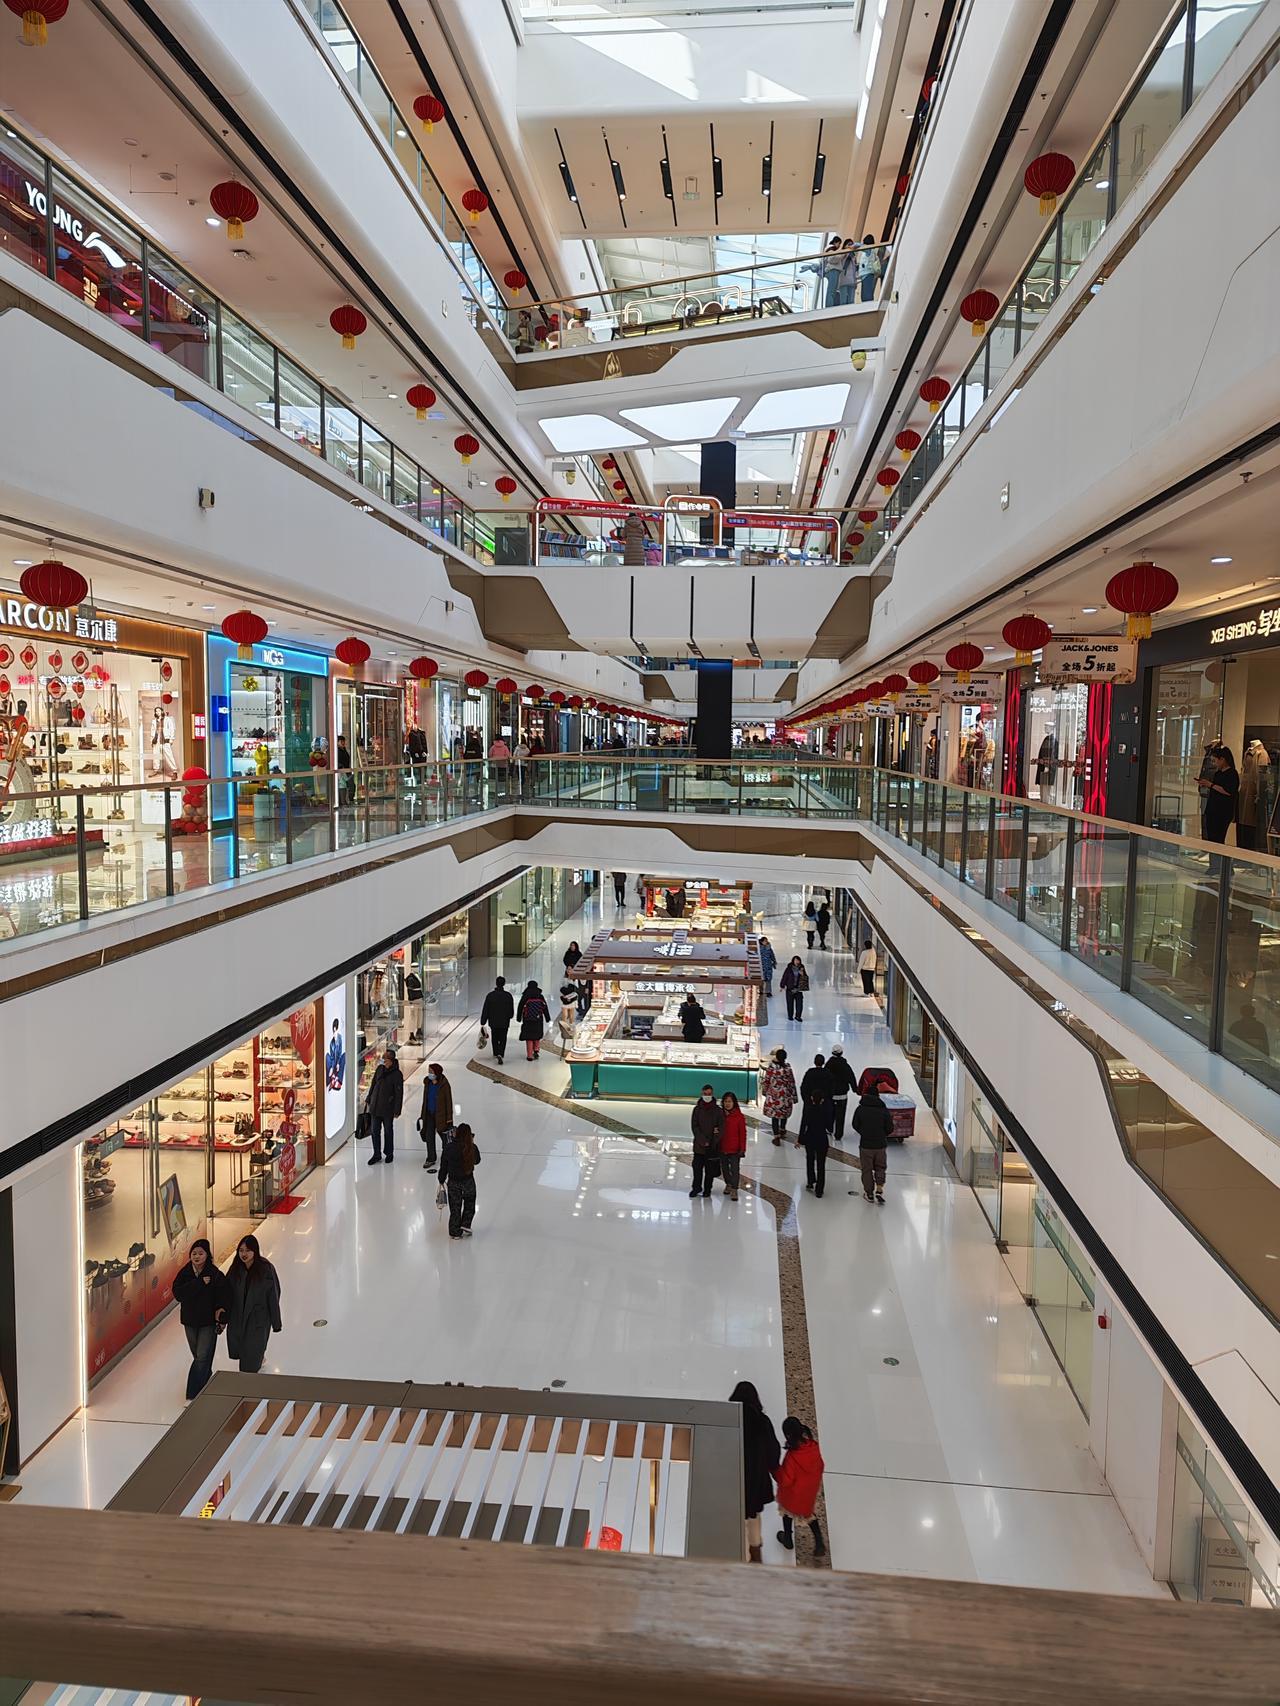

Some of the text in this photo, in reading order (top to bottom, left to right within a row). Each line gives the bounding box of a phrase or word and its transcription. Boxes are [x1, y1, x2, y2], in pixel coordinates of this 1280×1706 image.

[1061, 644, 1119, 652] JACK&JONES
[1061, 655, 1116, 672] 全场5折起
